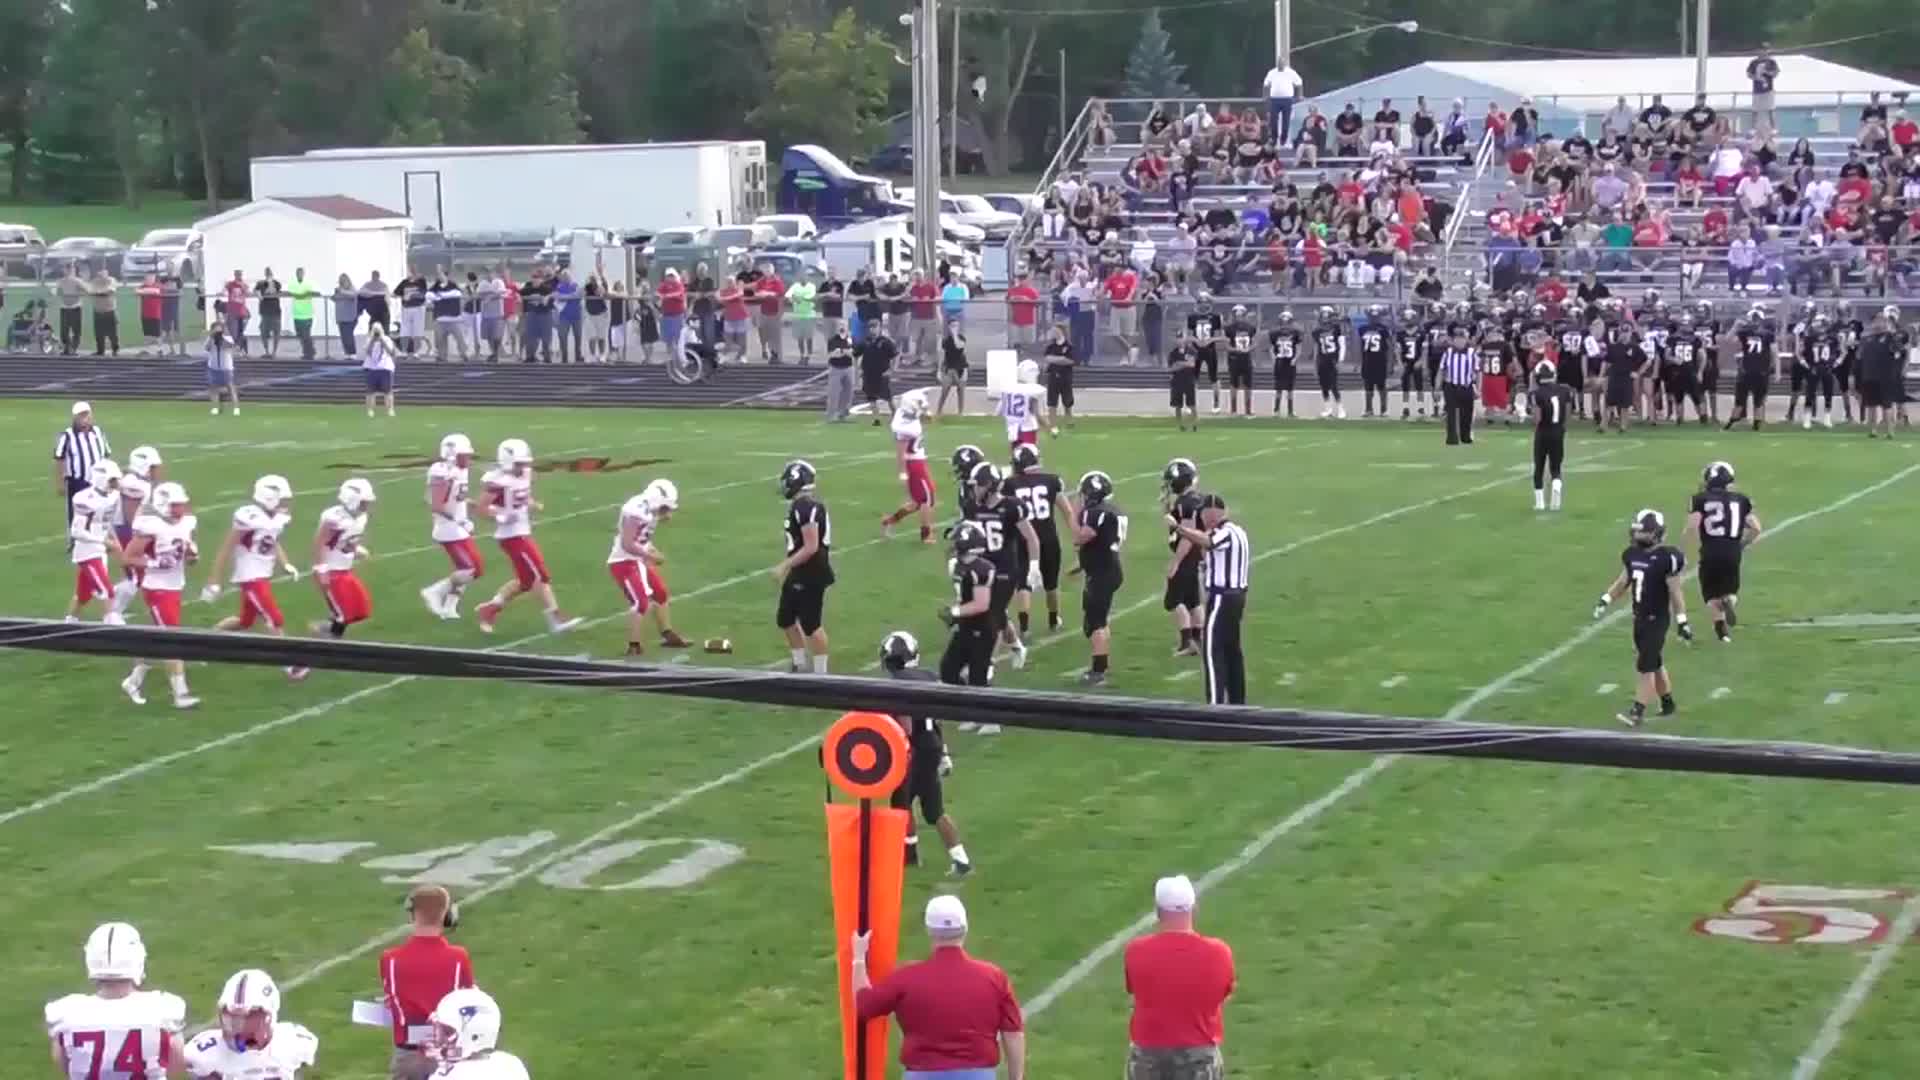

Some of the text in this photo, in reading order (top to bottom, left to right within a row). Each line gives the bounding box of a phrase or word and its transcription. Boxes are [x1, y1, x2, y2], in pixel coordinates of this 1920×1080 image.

[1406, 341, 1415, 359] 3
[1007, 393, 1025, 417] 12
[1551, 396, 1560, 423] 1
[1704, 501, 1740, 537] 21
[977, 521, 1003, 551] 6
[1632, 569, 1645, 602] 7
[1690, 880, 1914, 944] 5
[72, 1029, 147, 1080] 74
